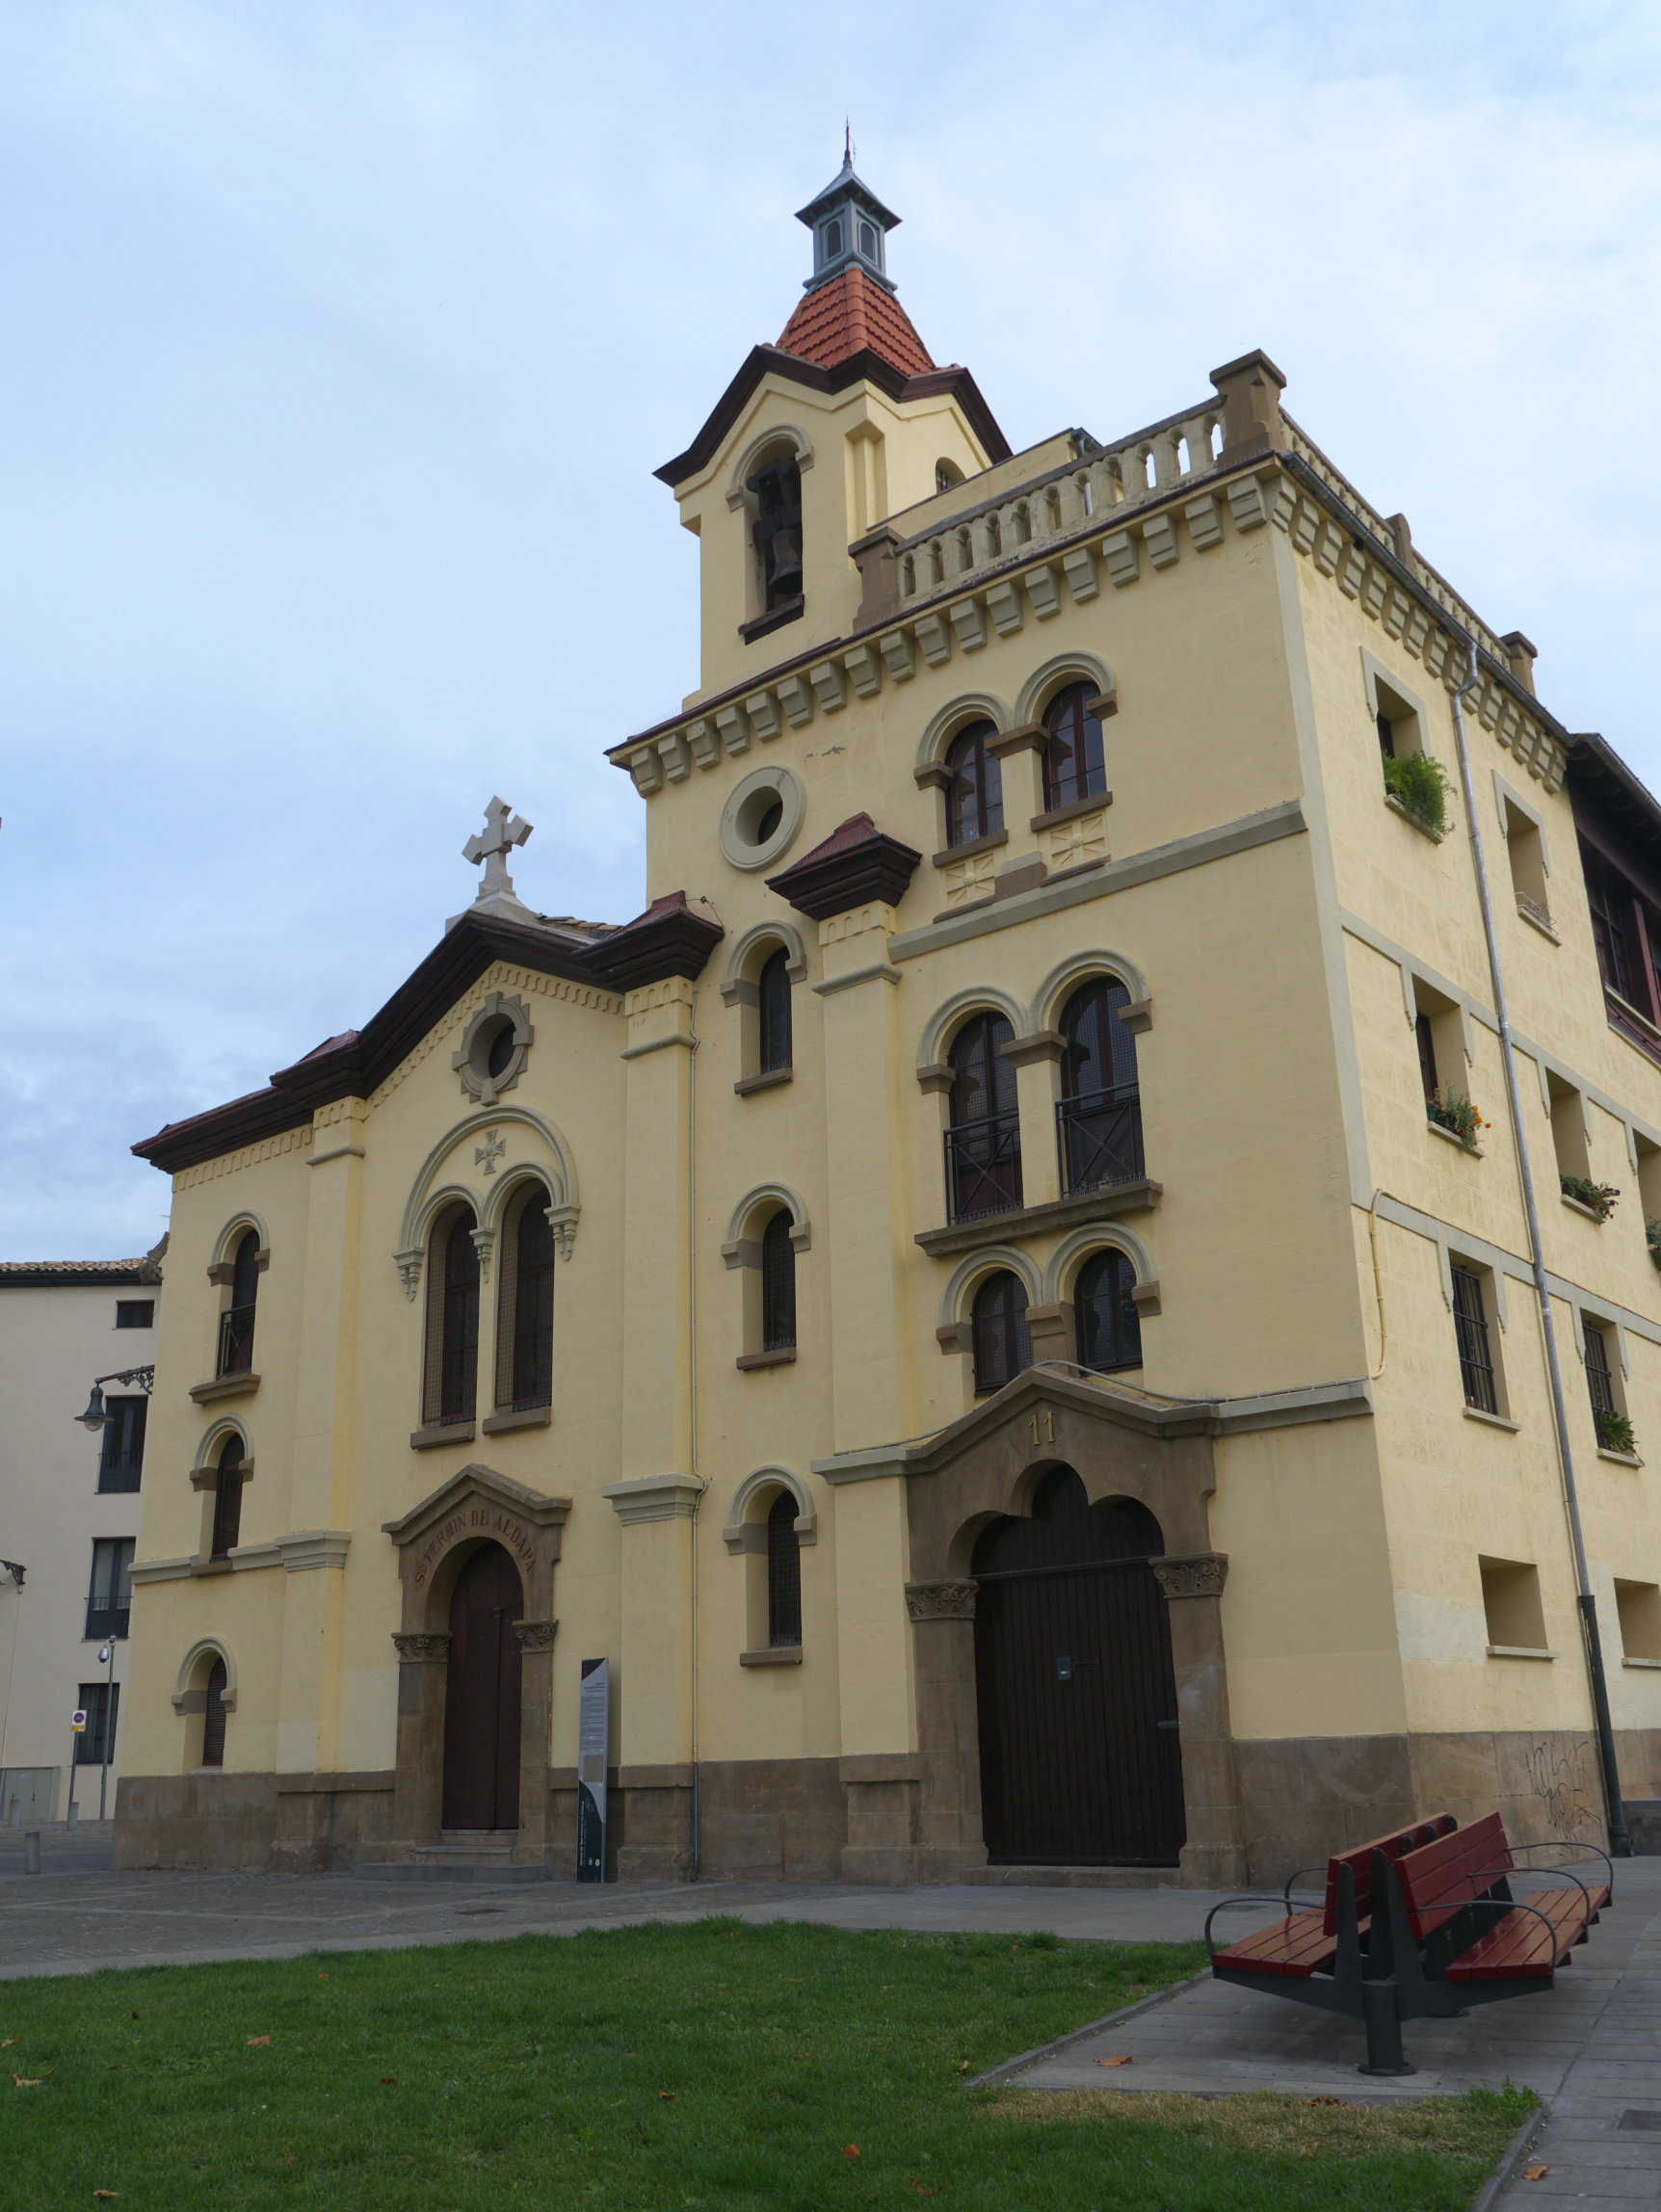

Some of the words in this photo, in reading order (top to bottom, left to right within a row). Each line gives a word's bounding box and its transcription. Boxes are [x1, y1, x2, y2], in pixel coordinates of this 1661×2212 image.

[1028, 1411, 1055, 1445] 11
[424, 1514, 466, 1563] FERMIN
[471, 1510, 488, 1526] DE
[494, 1514, 537, 1572] ALDAPA
